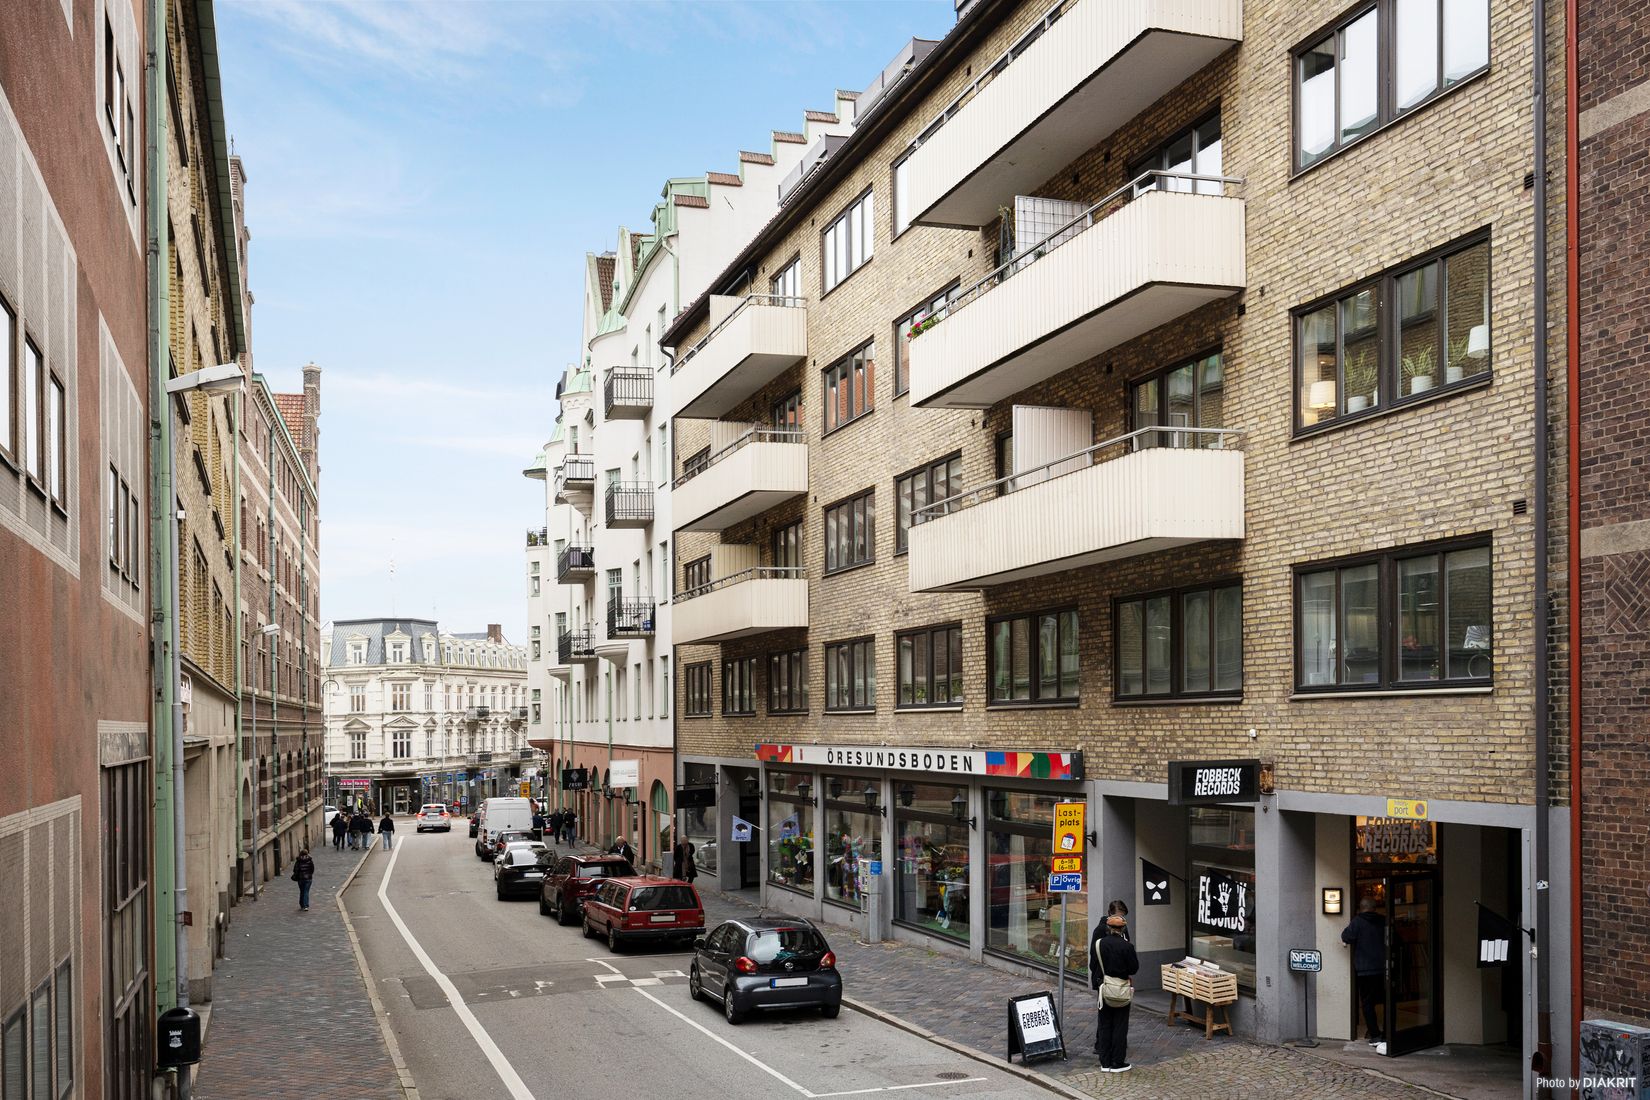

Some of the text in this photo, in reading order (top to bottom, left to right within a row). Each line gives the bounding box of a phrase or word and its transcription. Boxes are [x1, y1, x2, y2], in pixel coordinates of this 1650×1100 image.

[827, 748, 972, 772] ÖRESUNDSBODEN
[1195, 768, 1242, 783] FOBBECK
[1194, 781, 1240, 796] RECORDS
[1058, 809, 1081, 817] Last-
[1060, 818, 1080, 828] plats
[1363, 834, 1428, 853] RECORDS
[1062, 875, 1081, 885] Övrig
[1292, 952, 1319, 963] OPEN
[1022, 1008, 1049, 1021] FOBBECK
[1023, 1016, 1050, 1029] RECORDS
